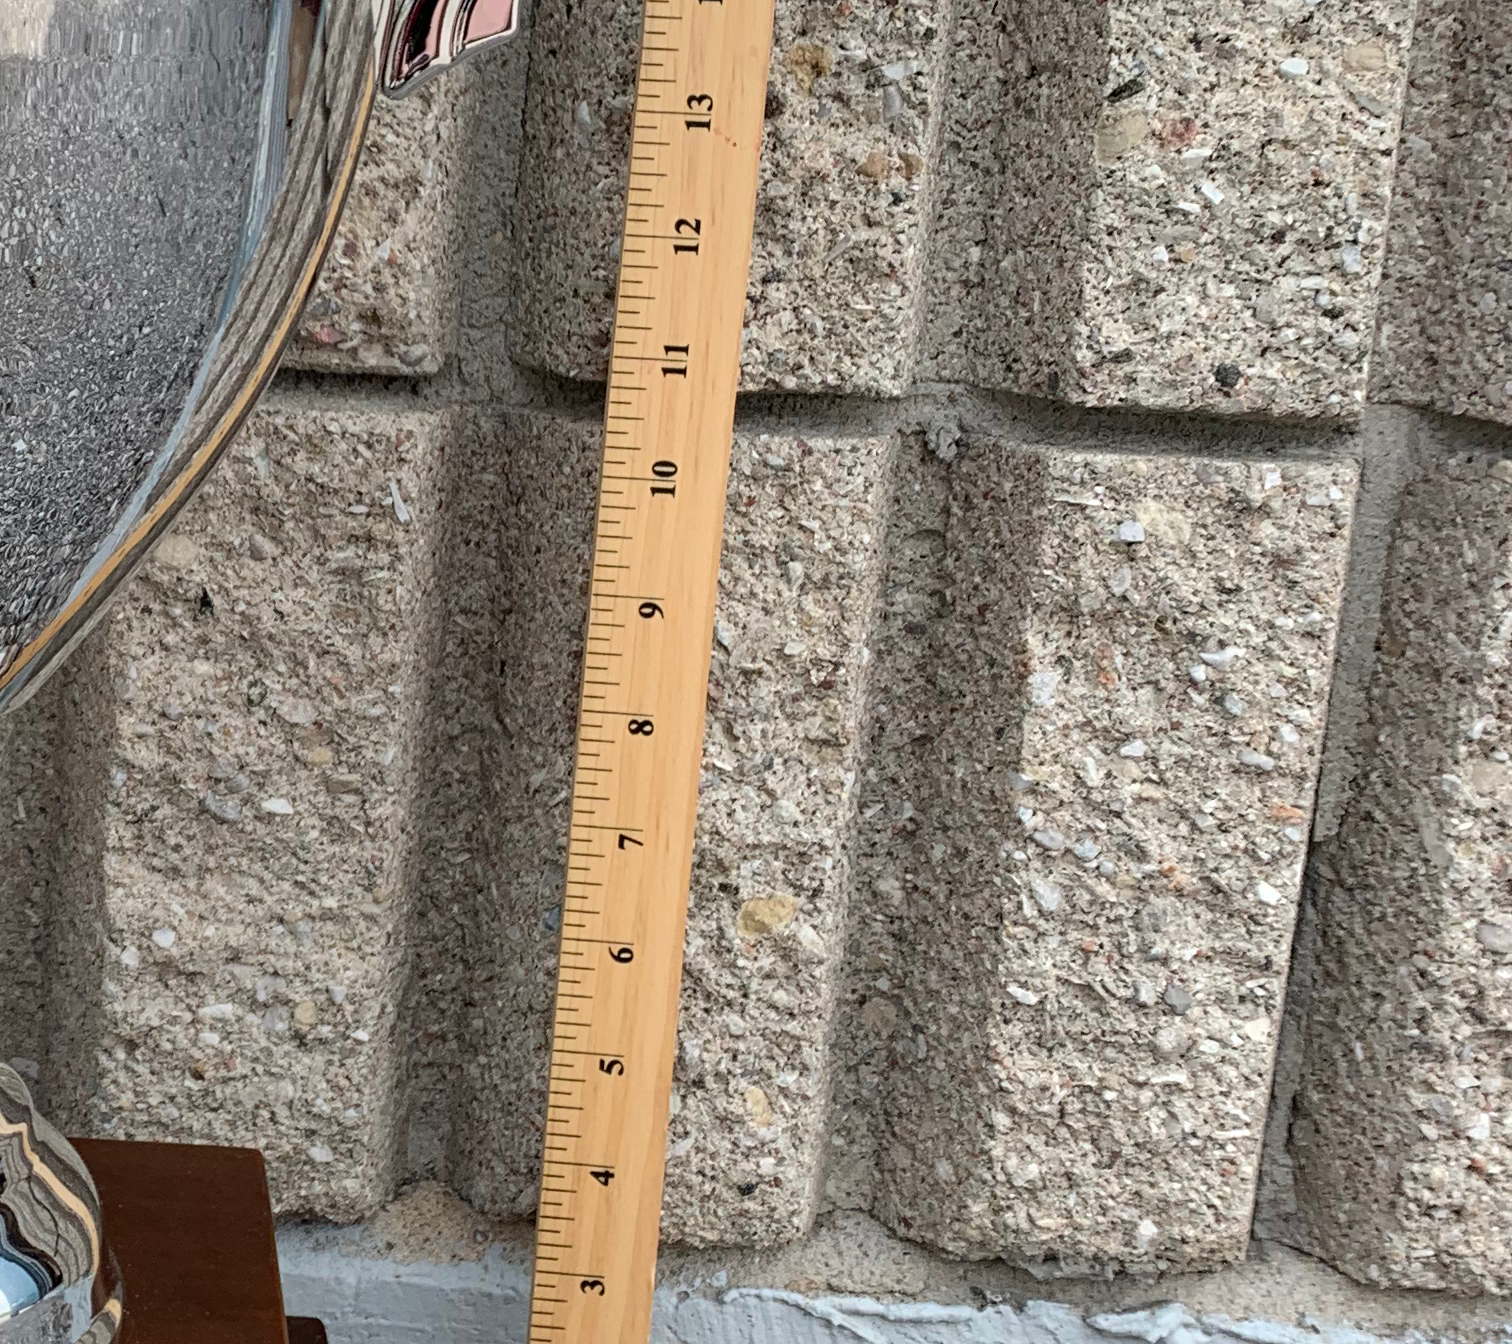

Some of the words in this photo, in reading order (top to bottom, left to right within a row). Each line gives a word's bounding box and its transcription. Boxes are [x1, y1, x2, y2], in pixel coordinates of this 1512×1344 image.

[686, 93, 714, 132] 13
[674, 217, 702, 256] 12
[662, 343, 690, 378] 11
[651, 460, 679, 498] 10
[638, 601, 665, 620] 9
[628, 719, 655, 737] 8
[618, 834, 644, 851] 7
[608, 947, 634, 963] 6
[599, 1059, 624, 1077] 5
[589, 1169, 615, 1187] 4
[580, 1279, 606, 1296] 3
